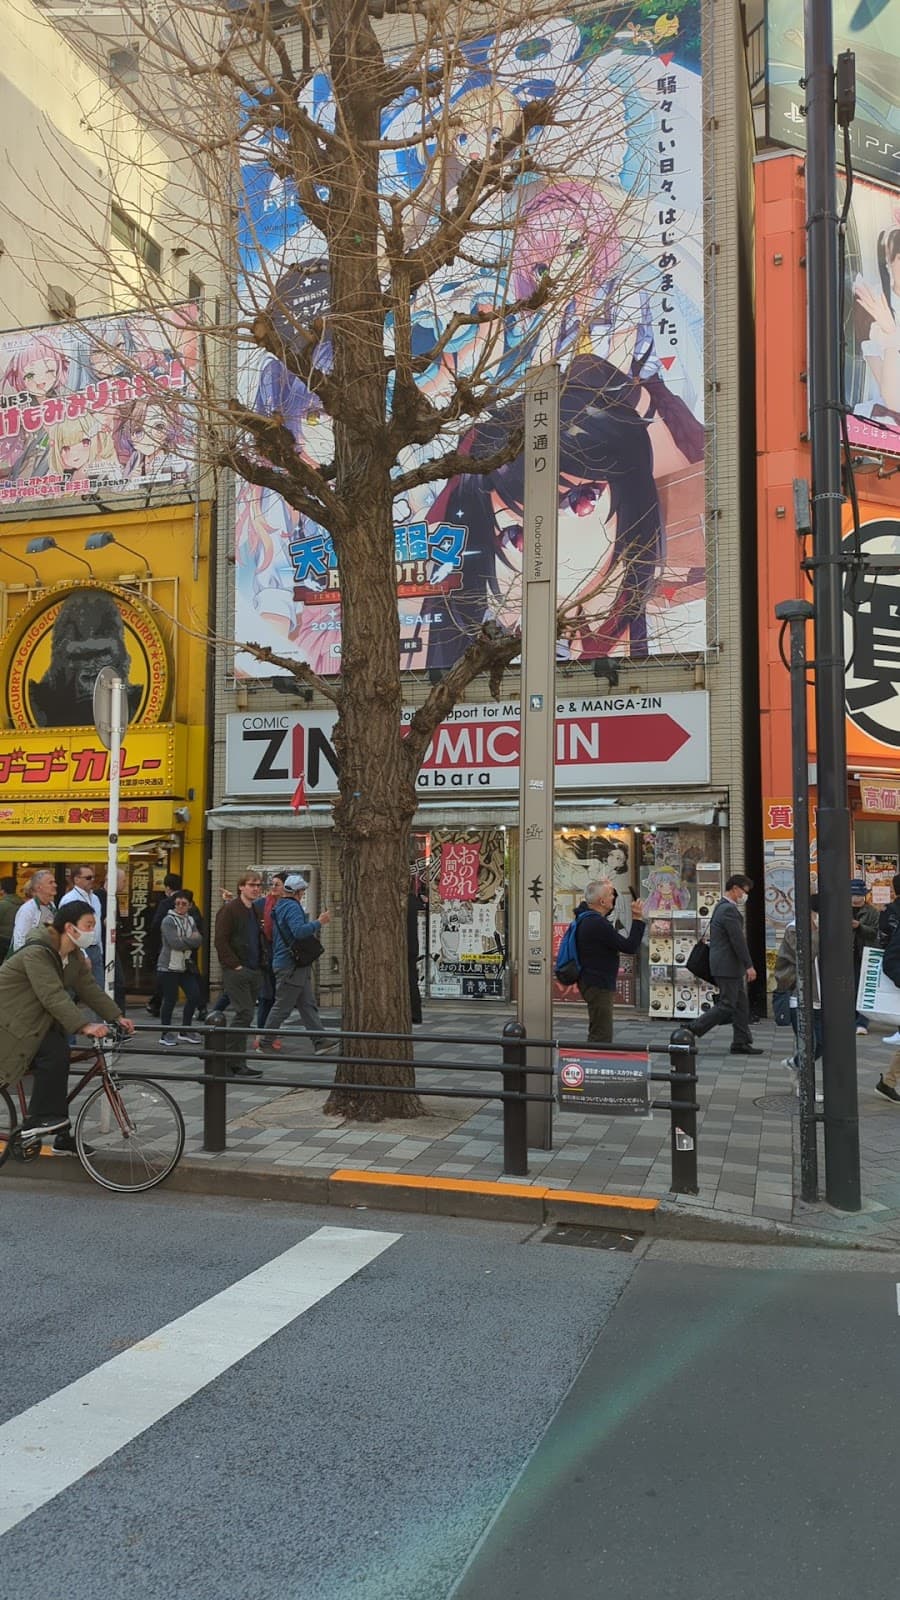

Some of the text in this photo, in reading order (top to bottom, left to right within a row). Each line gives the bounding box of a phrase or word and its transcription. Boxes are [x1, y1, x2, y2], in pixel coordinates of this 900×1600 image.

[656, 75, 678, 346] 騒々しい日々、はじめました。
[532, 390, 549, 473] 中央通り
[483, 706, 500, 717] for
[568, 702, 577, 712] &
[581, 697, 662, 712] MANGA-ZIN
[242, 716, 289, 729] COMIC
[864, 786, 900, 810] 高価
[769, 806, 793, 830] 質
[457, 846, 478, 895] おのれ
[863, 950, 884, 1010] KOTOBUKIYA
